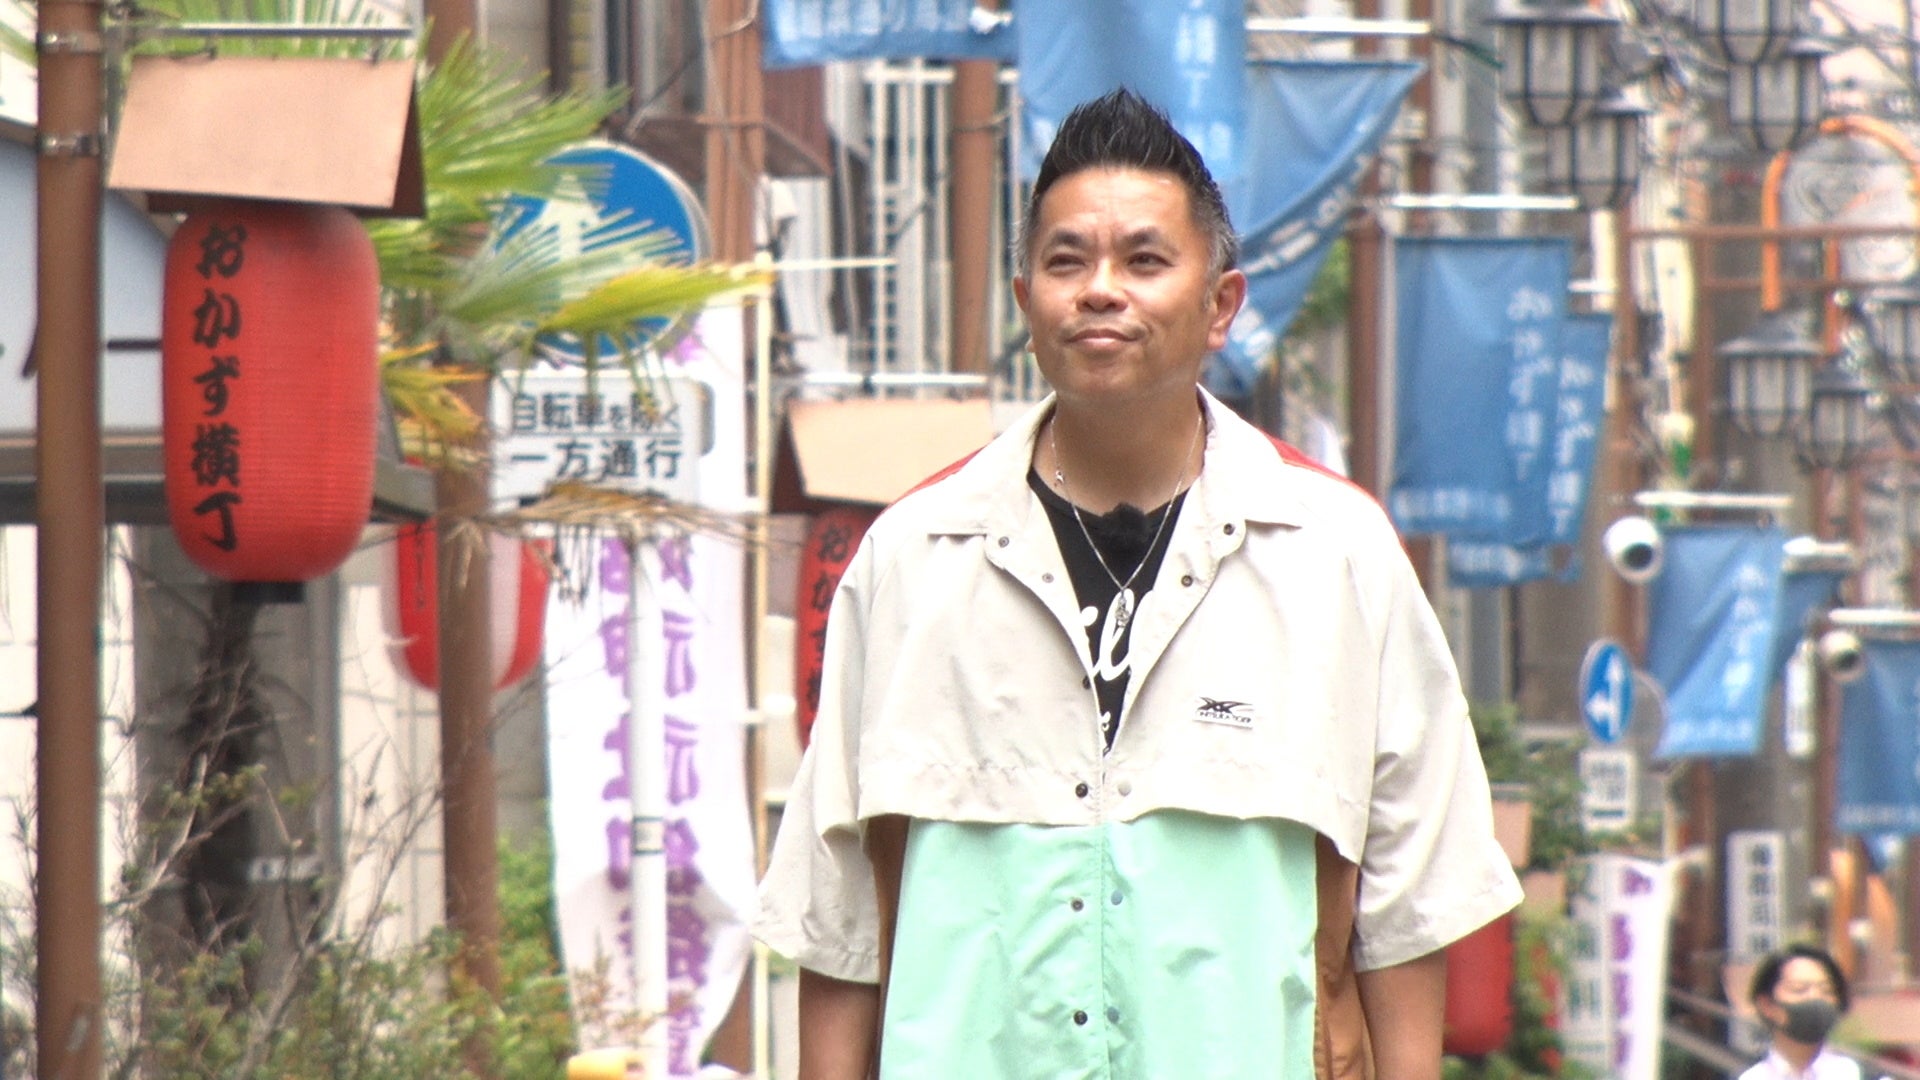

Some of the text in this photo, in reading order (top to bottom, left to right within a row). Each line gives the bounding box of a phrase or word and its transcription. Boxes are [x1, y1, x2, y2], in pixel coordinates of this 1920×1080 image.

[191, 222, 247, 552] おかず横丁
[512, 391, 682, 431] 自転車を除く
[511, 437, 683, 482] 一方通行
